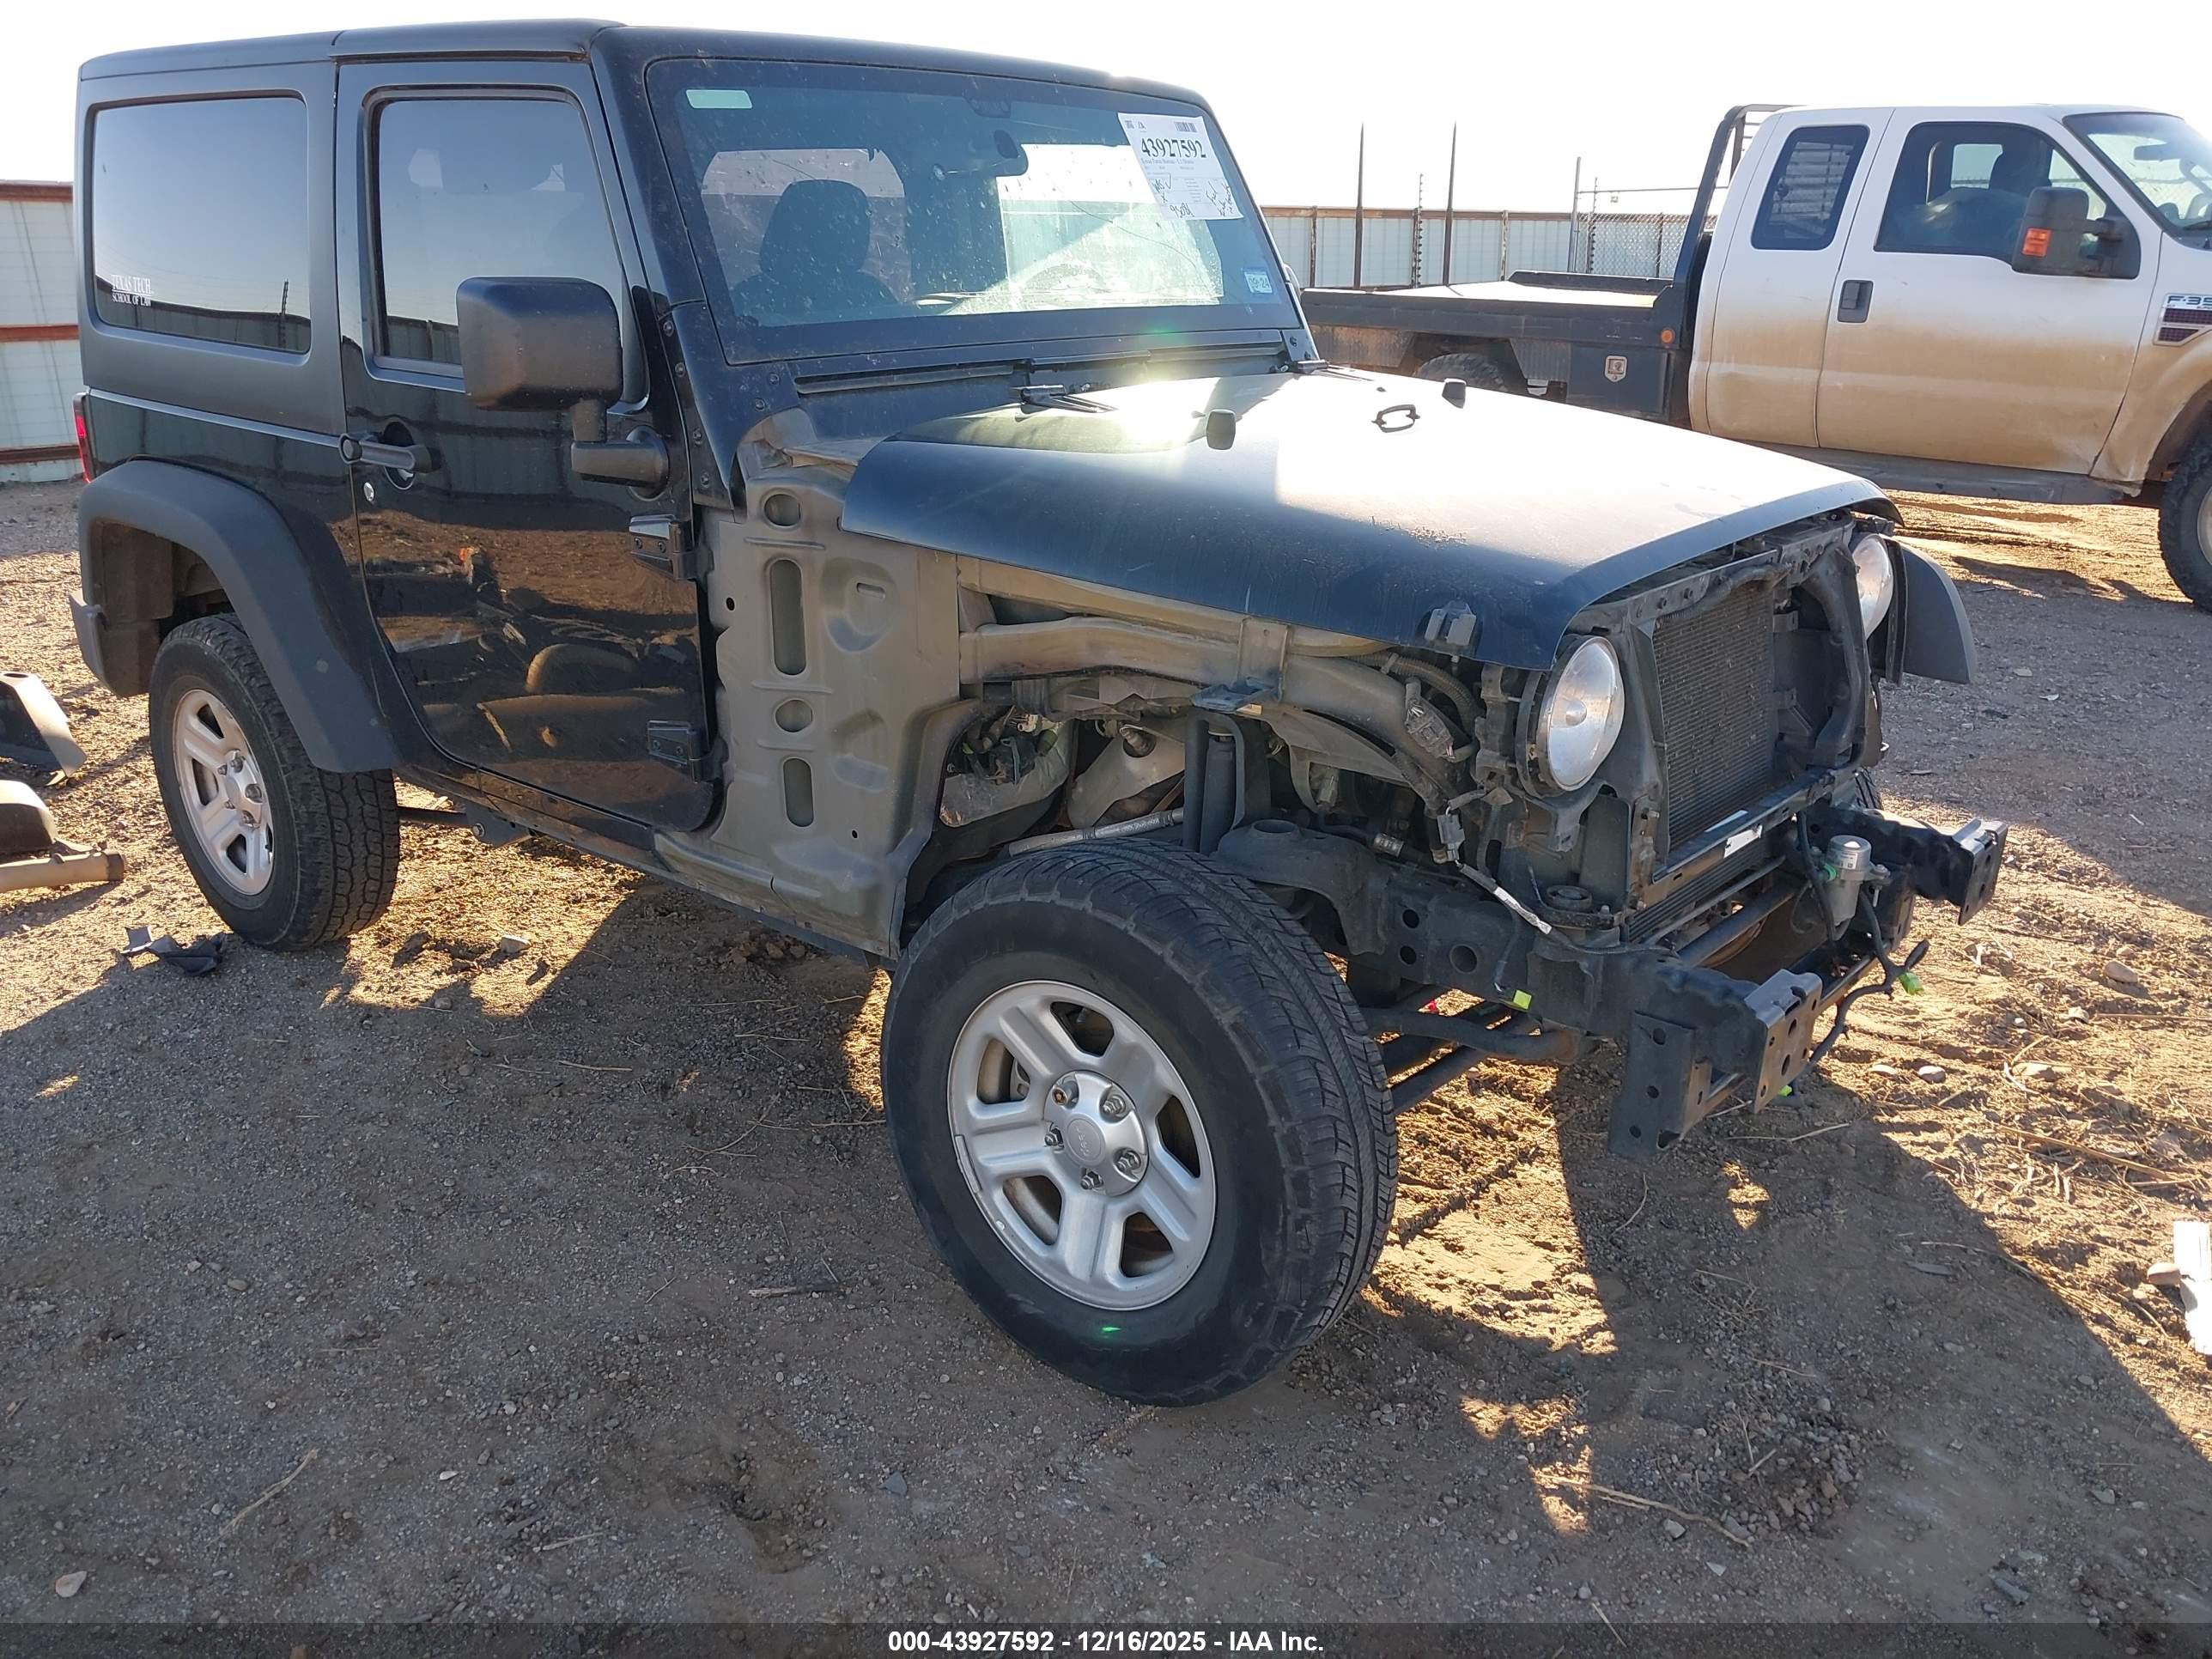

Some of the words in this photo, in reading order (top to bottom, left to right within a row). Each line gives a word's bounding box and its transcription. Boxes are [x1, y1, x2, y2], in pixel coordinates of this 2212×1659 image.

[1141, 137, 1207, 159] 43927592
[111, 274, 132, 292] TEXAS
[132, 276, 152, 295] TECH
[112, 292, 132, 305] SCHOOL
[131, 295, 139, 306] OF
[140, 295, 152, 307] LAW
